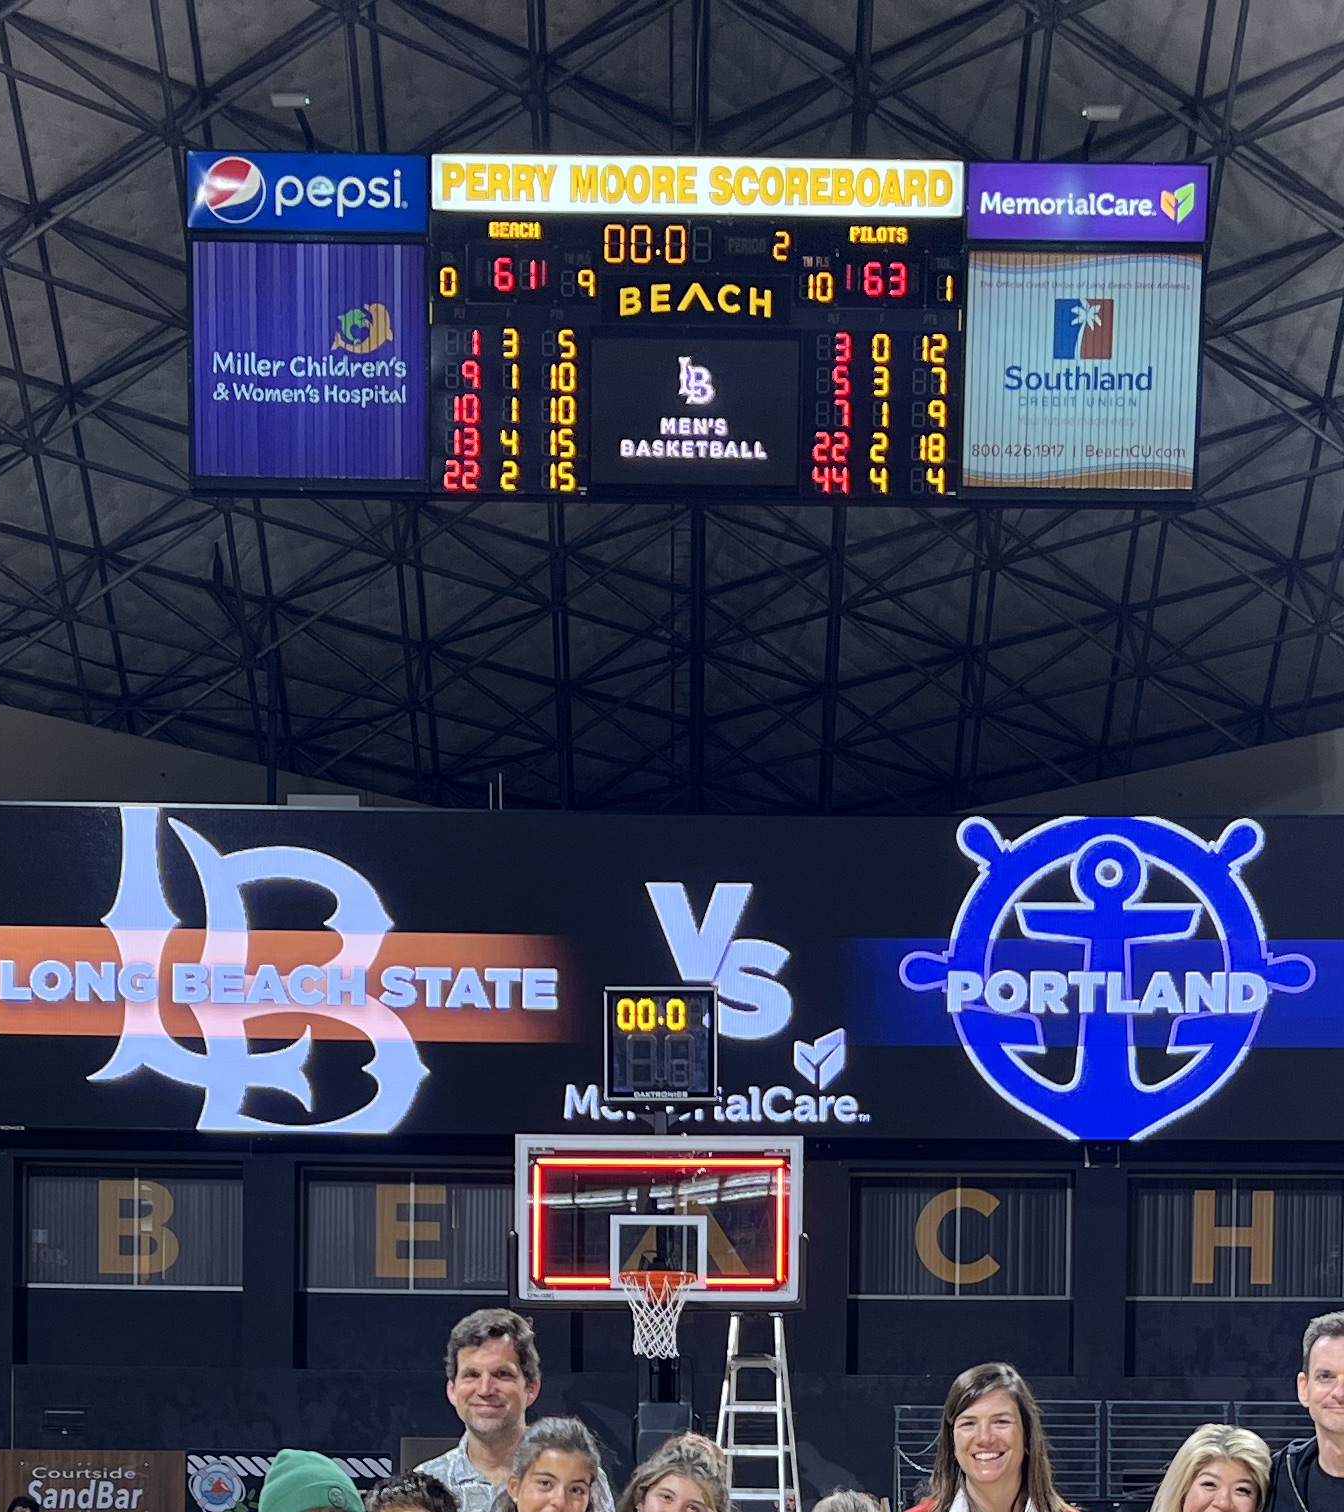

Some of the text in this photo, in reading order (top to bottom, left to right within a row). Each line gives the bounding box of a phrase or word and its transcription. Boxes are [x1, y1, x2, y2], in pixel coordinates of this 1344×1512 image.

[275, 168, 402, 218] pepsi
[442, 162, 953, 207] PERRY MOORE SCOREBOARD
[980, 191, 1155, 216] MemorialCare
[489, 221, 542, 239] BEACH
[604, 224, 687, 264] 00.0
[772, 230, 791, 261] 2
[849, 226, 909, 244] PILOTS
[439, 266, 458, 297] 0
[577, 268, 597, 297] 9
[807, 271, 834, 303] 10
[862, 261, 907, 297] 63
[945, 274, 954, 301] 1
[502, 327, 520, 359] 3
[557, 328, 577, 359] 5
[833, 331, 949, 364] 3 0 12
[213, 352, 407, 378] Miller Children's
[461, 359, 482, 390] 9
[549, 361, 577, 393] 10
[677, 355, 715, 405] LB
[831, 365, 949, 397] 5 3 7
[1004, 366, 1153, 391] Southland
[213, 382, 407, 408] & Women's Hospital
[453, 393, 482, 424] 10
[549, 395, 577, 426] 10
[659, 417, 728, 435] MEN'S
[833, 399, 852, 429] 7
[927, 399, 948, 430] 9
[453, 426, 577, 459] 13 4 15
[619, 438, 768, 460] BASKETBALL
[811, 431, 946, 464] 22 2 18
[443, 459, 577, 492] 22 2 15
[811, 466, 946, 495] 44 4 4
[87, 806, 431, 1133] LB
[644, 881, 793, 1040] VS
[0, 960, 559, 1012] LONG BEACH STATE
[946, 970, 1270, 1015] PORTLAND
[616, 998, 687, 1031] 00.0
[32, 1467, 136, 1479] Courtside
[27, 1479, 143, 1510] SandBar
